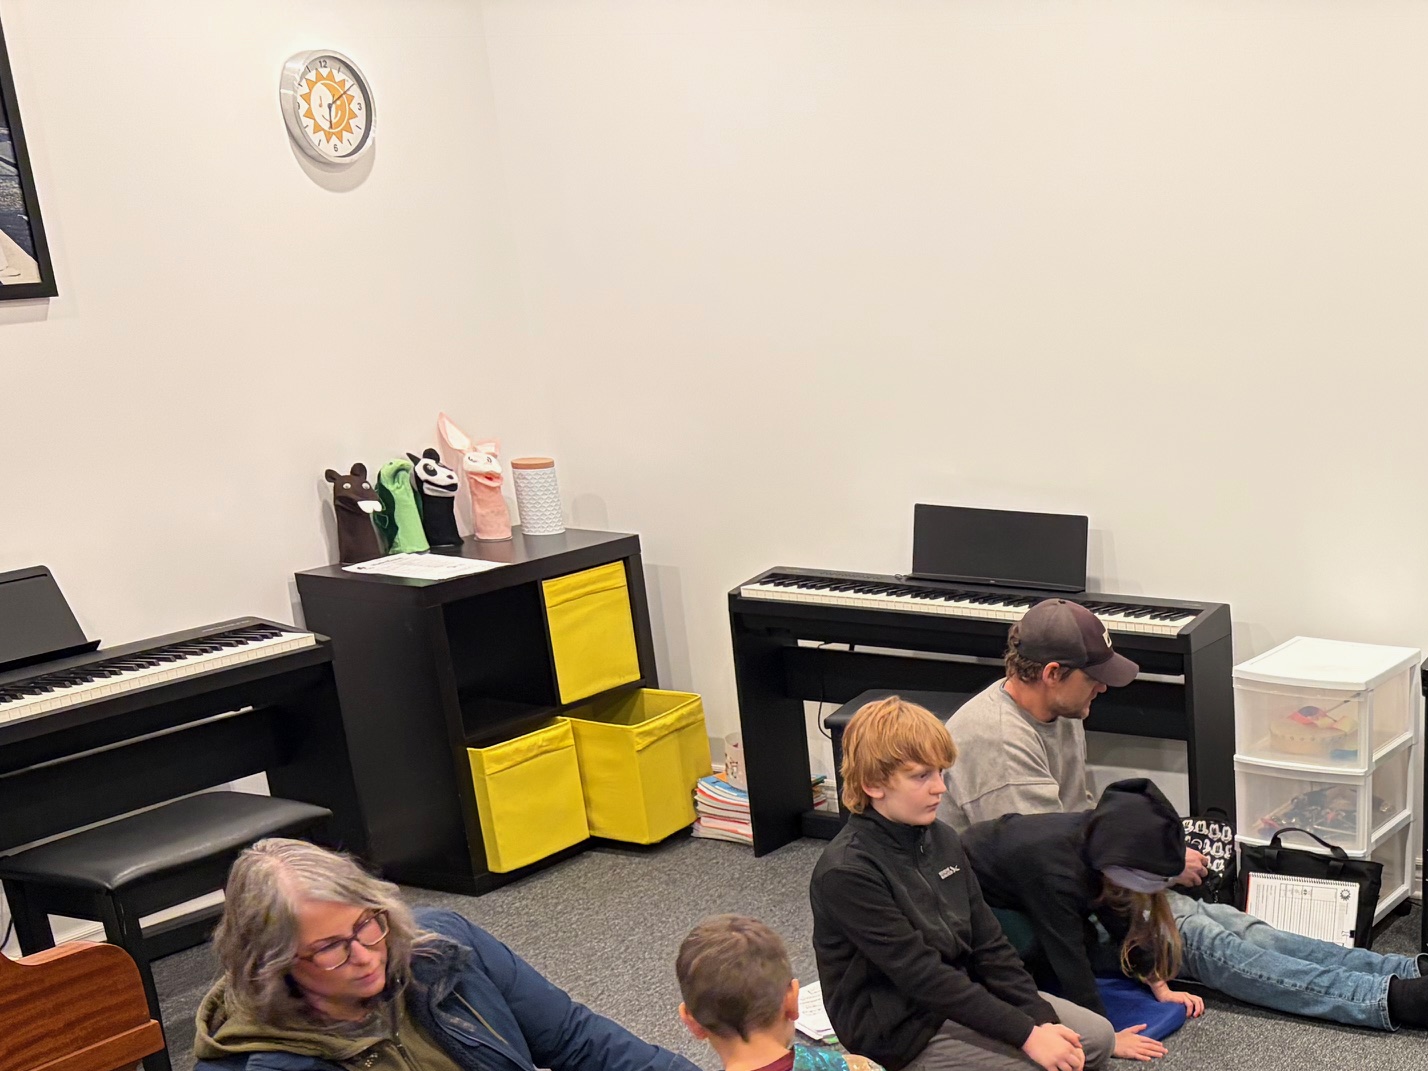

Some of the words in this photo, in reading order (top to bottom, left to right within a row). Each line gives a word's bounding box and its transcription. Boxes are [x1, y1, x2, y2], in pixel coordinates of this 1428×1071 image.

[319, 60, 328, 68] 12
[357, 102, 362, 111] 3
[334, 143, 339, 152] 6
